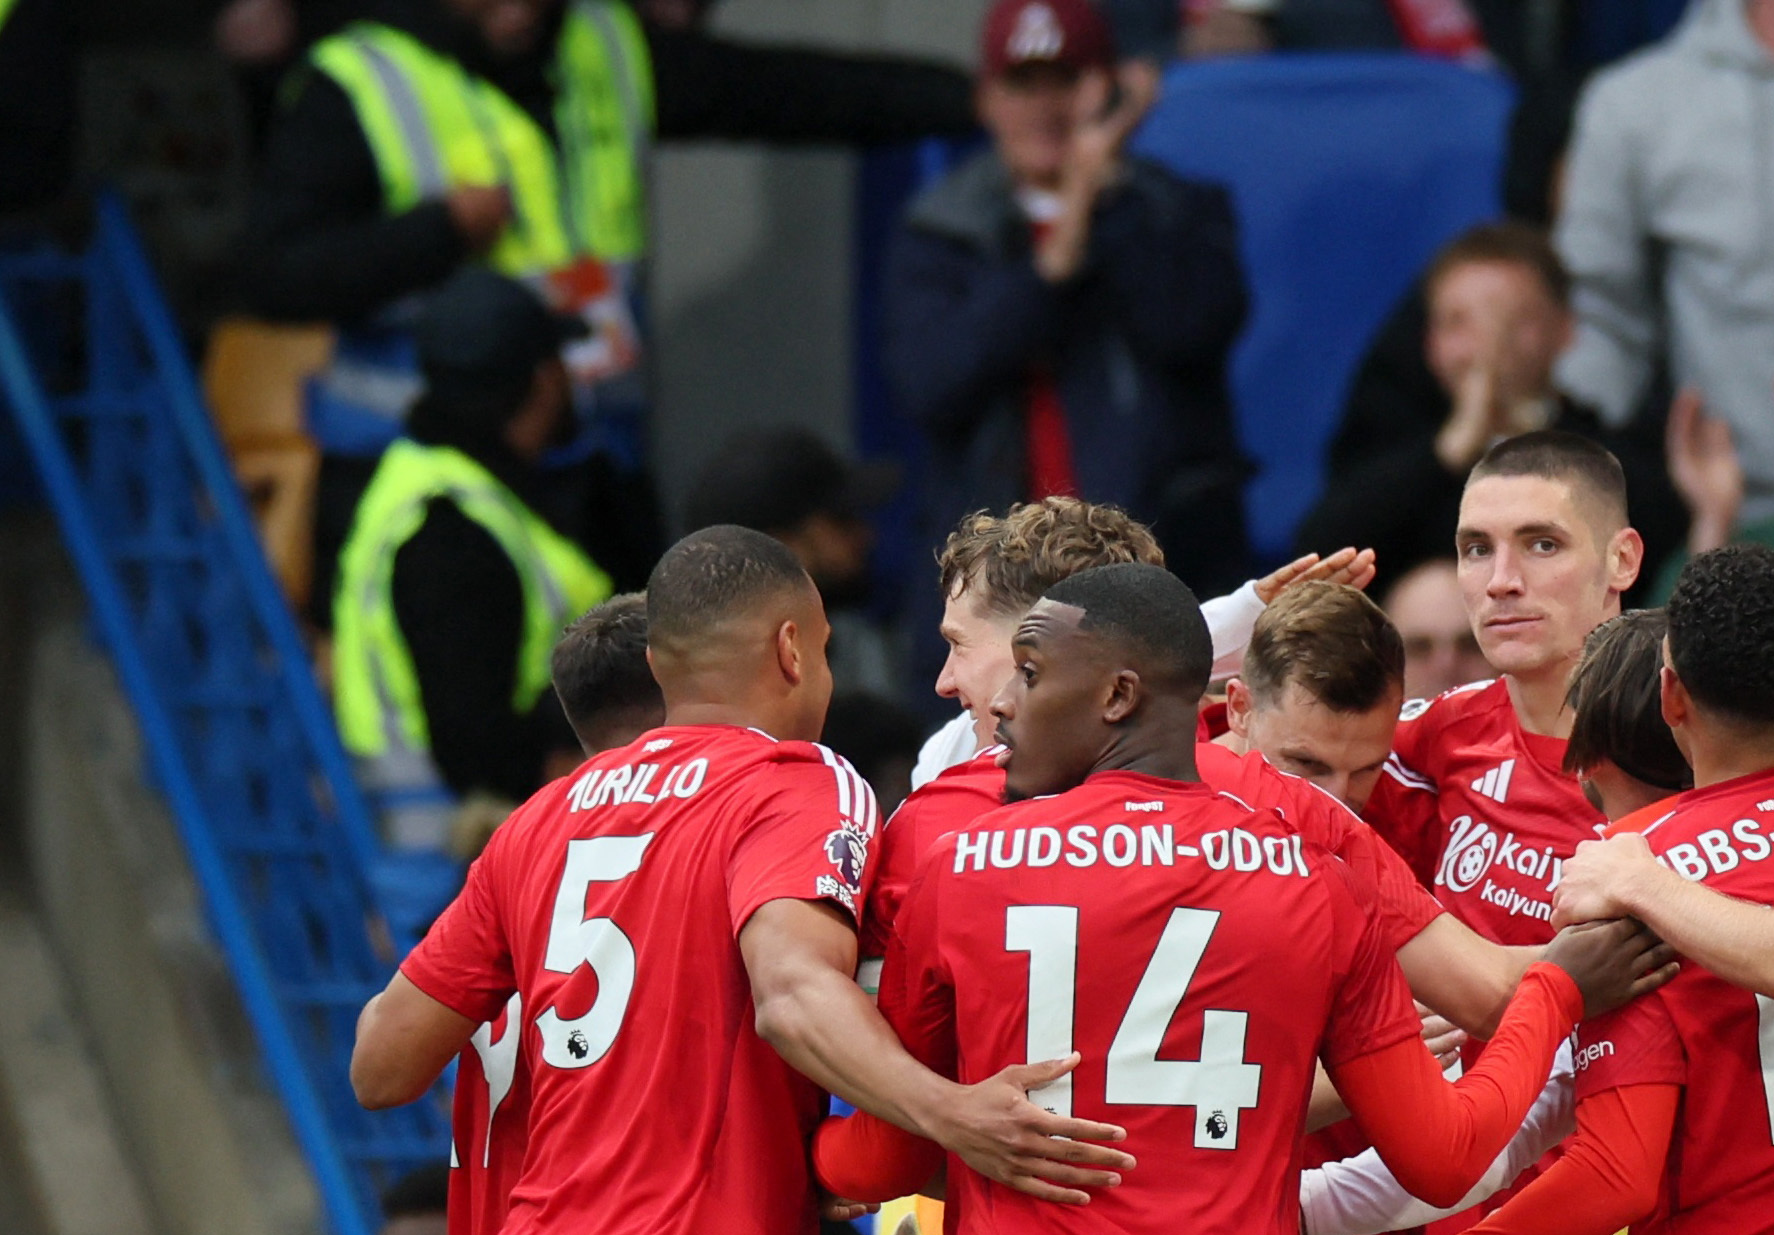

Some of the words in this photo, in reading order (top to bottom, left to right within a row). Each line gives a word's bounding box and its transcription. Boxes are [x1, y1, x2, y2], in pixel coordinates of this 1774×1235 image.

[535, 831, 655, 1070] 5
[953, 824, 1309, 877] HUDSON-ODOI
[1005, 904, 1262, 1151] 14
